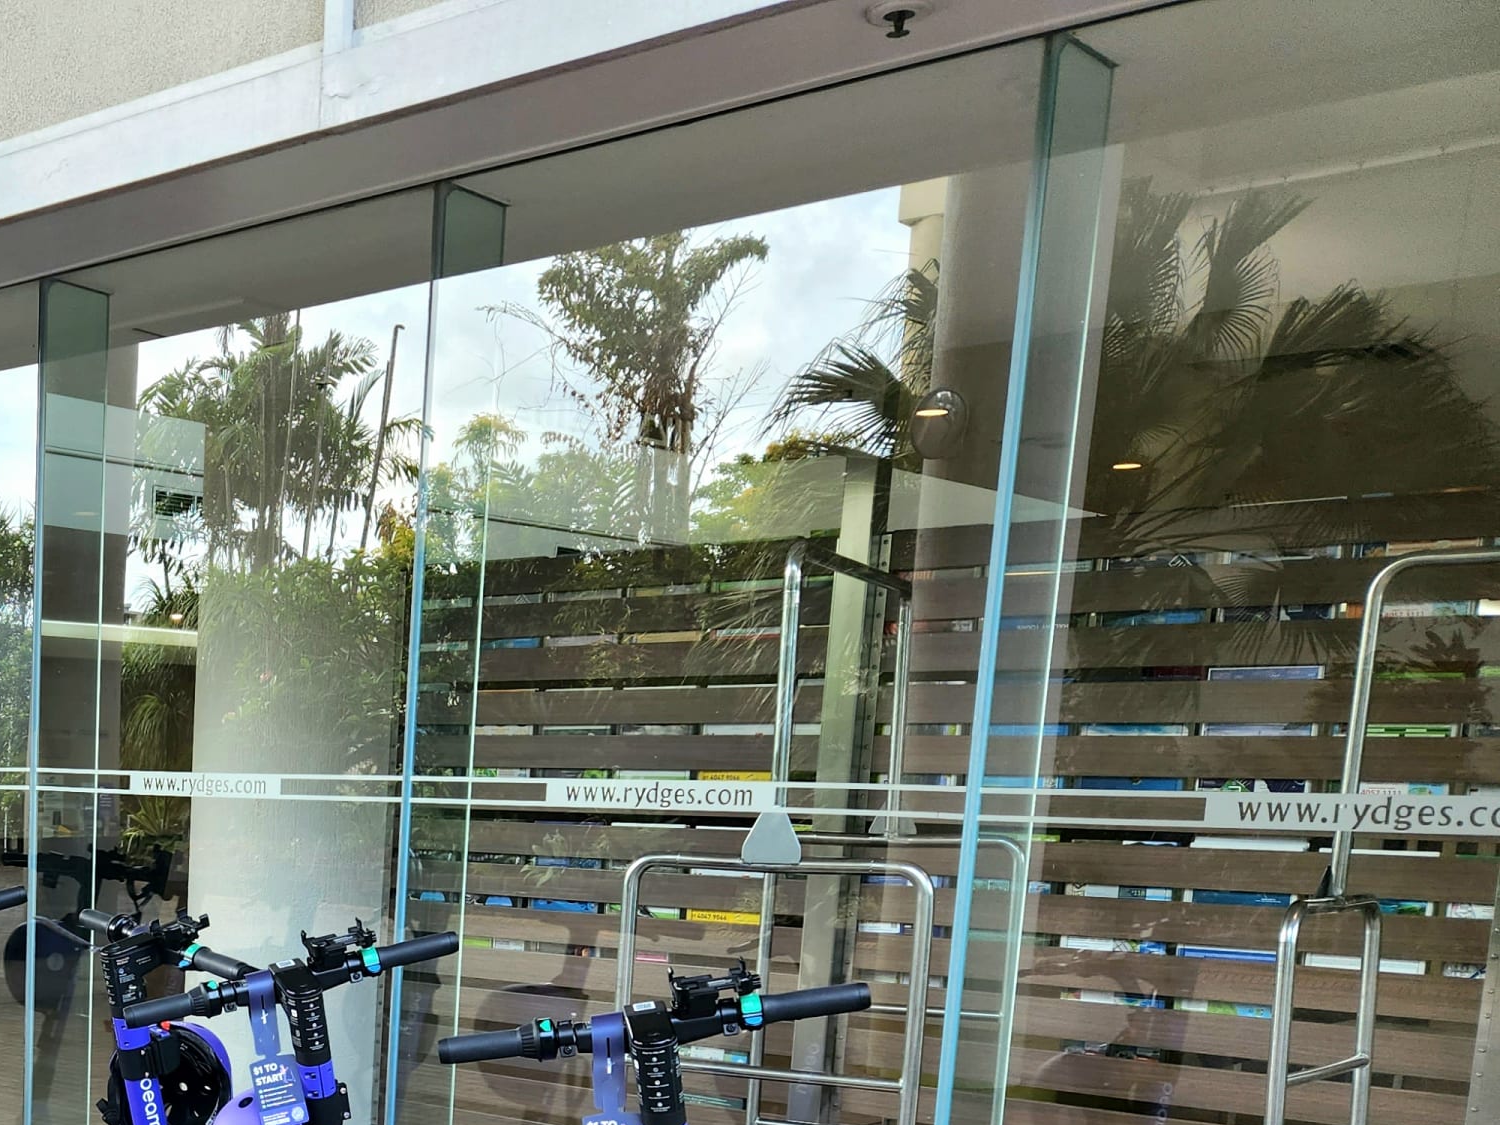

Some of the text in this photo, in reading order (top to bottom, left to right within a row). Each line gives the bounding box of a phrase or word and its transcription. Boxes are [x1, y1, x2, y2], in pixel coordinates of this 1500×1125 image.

[143, 775, 266, 796] www.rydges.com
[566, 782, 753, 808] www.rydges.com
[263, 1062, 278, 1073] TO
[255, 1072, 284, 1087] START
